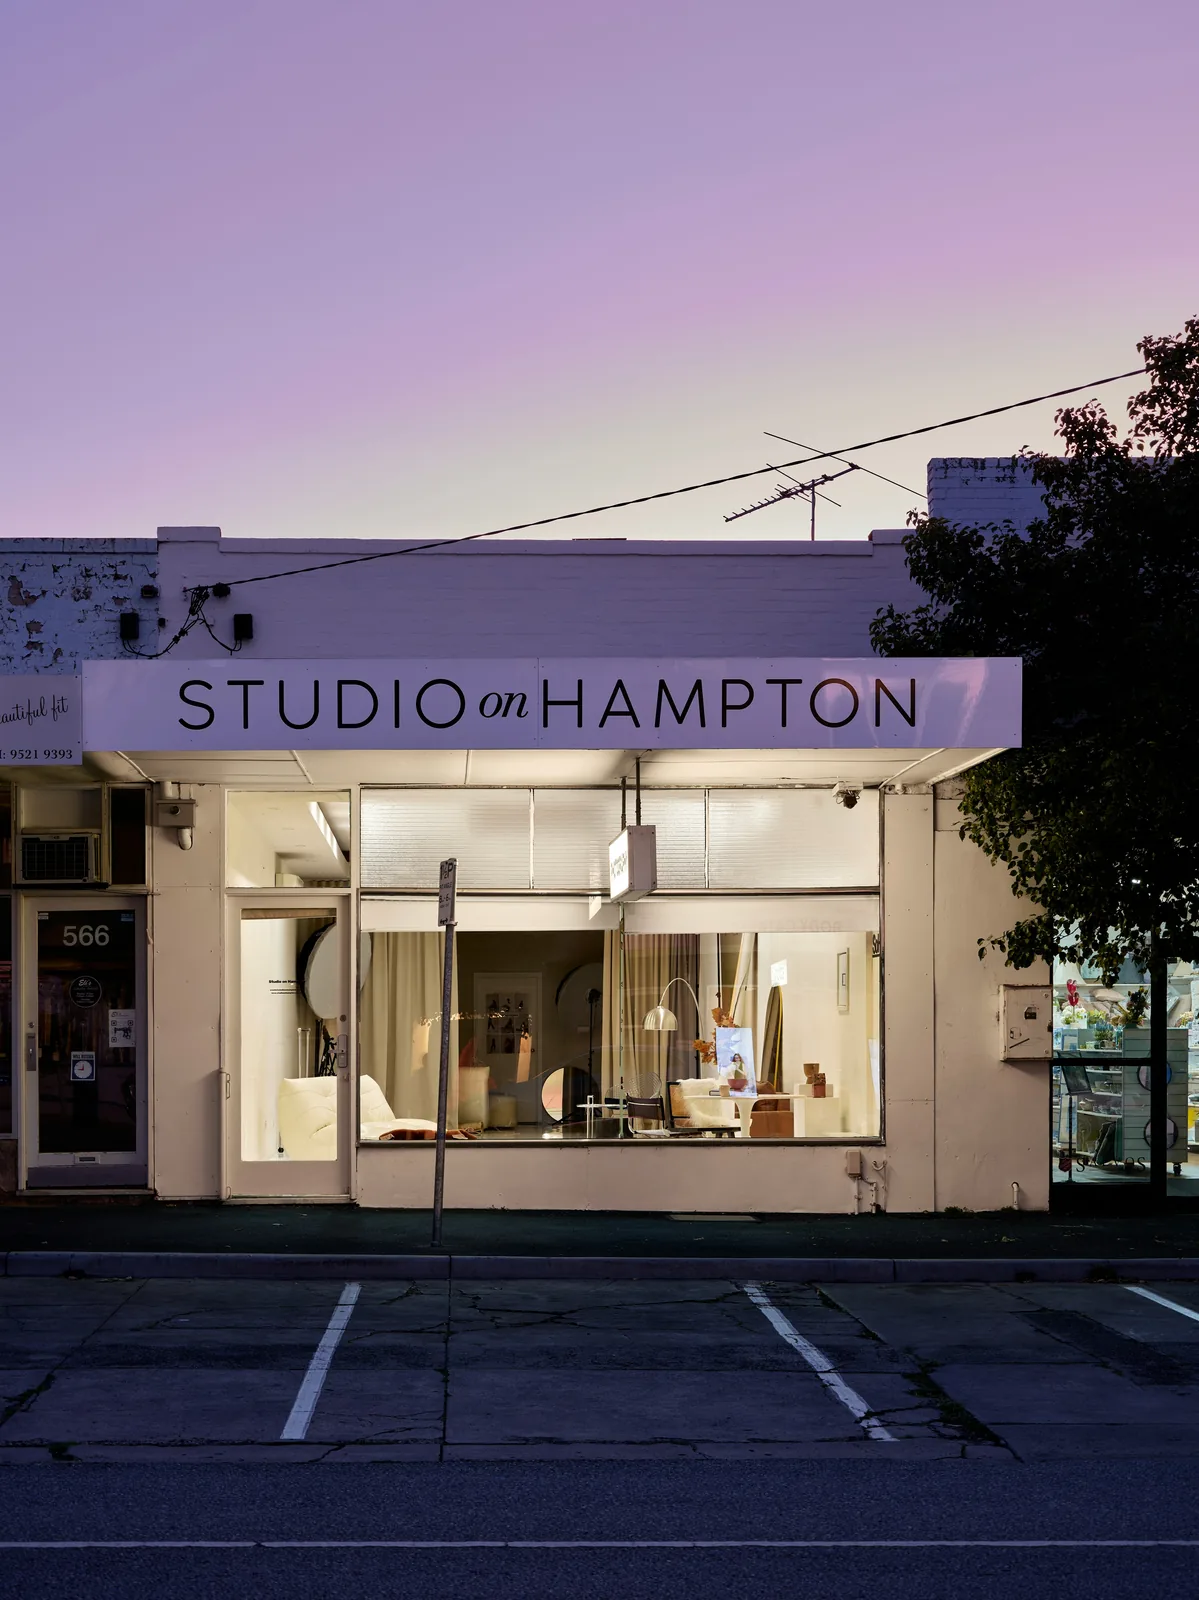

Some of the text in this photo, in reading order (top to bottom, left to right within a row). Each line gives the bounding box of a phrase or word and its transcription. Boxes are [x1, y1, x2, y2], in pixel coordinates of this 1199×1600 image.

[51, 694, 69, 722] fit
[178, 678, 916, 730] STUDIO on HAMPTON
[10, 749, 39, 760] 9521
[43, 749, 73, 760] 9393
[62, 924, 110, 947] 566
